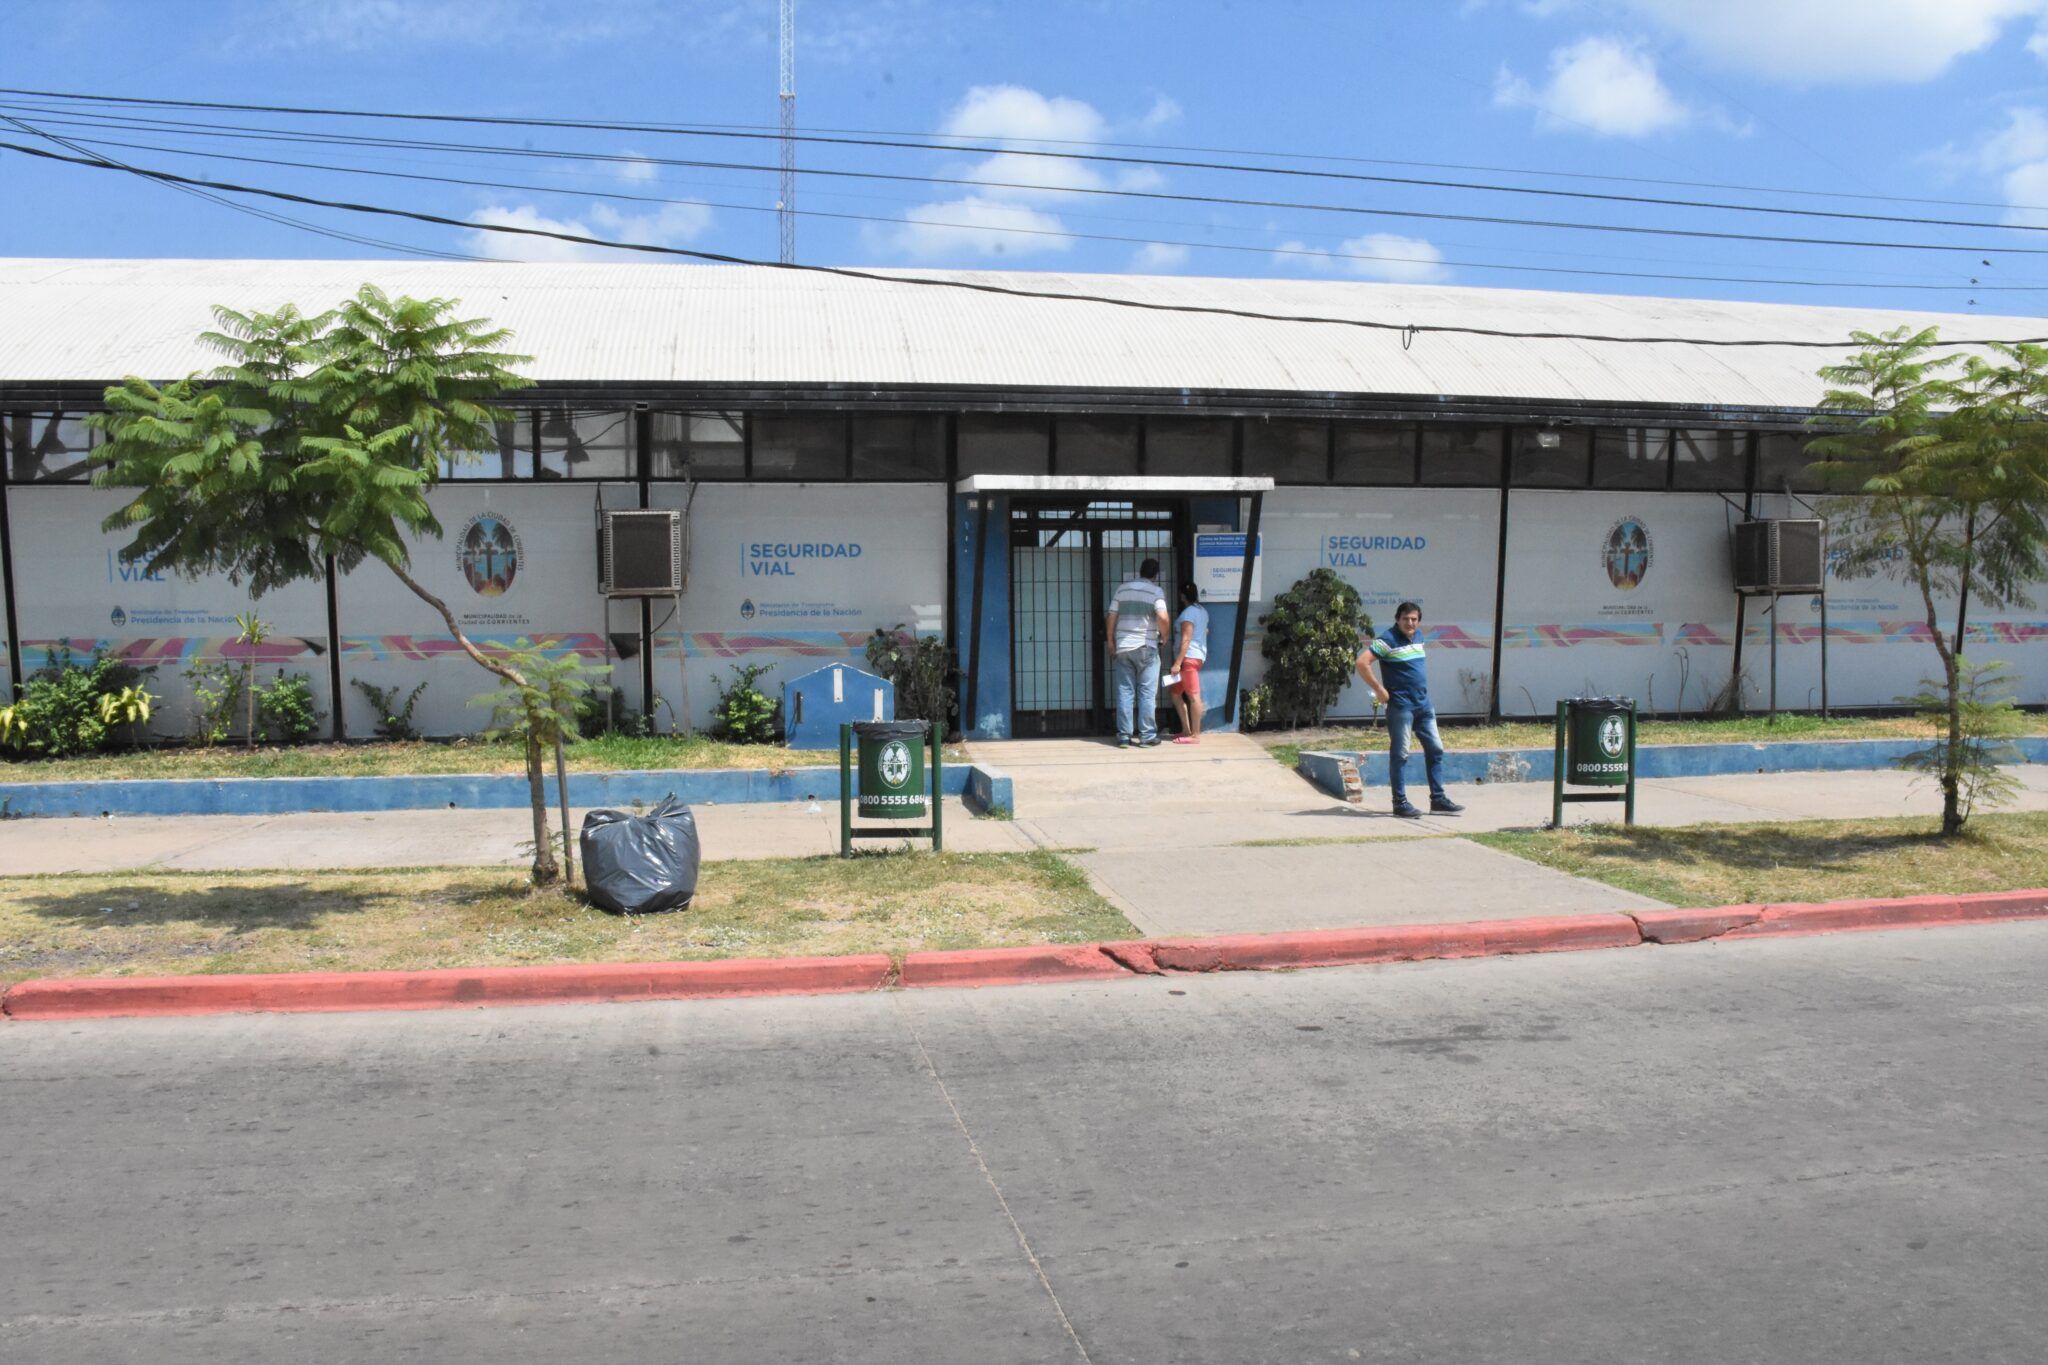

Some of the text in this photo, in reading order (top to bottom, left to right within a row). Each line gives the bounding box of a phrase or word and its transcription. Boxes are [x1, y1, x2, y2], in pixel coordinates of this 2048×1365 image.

[1328, 536, 1426, 550] SEGURIDAD
[750, 544, 862, 558] SEGURIDAD
[1328, 553, 1367, 566] VIAL
[750, 561, 796, 576] VIAL
[810, 608, 822, 616] de
[823, 608, 831, 616] la
[832, 608, 862, 616] Nación
[131, 616, 182, 624] Presidencia
[185, 616, 195, 624] de
[198, 616, 205, 624] la
[1577, 763, 1601, 772] 0800
[1602, 763, 1623, 772] 5555
[860, 795, 880, 805] 0800
[880, 795, 908, 805] 5555
